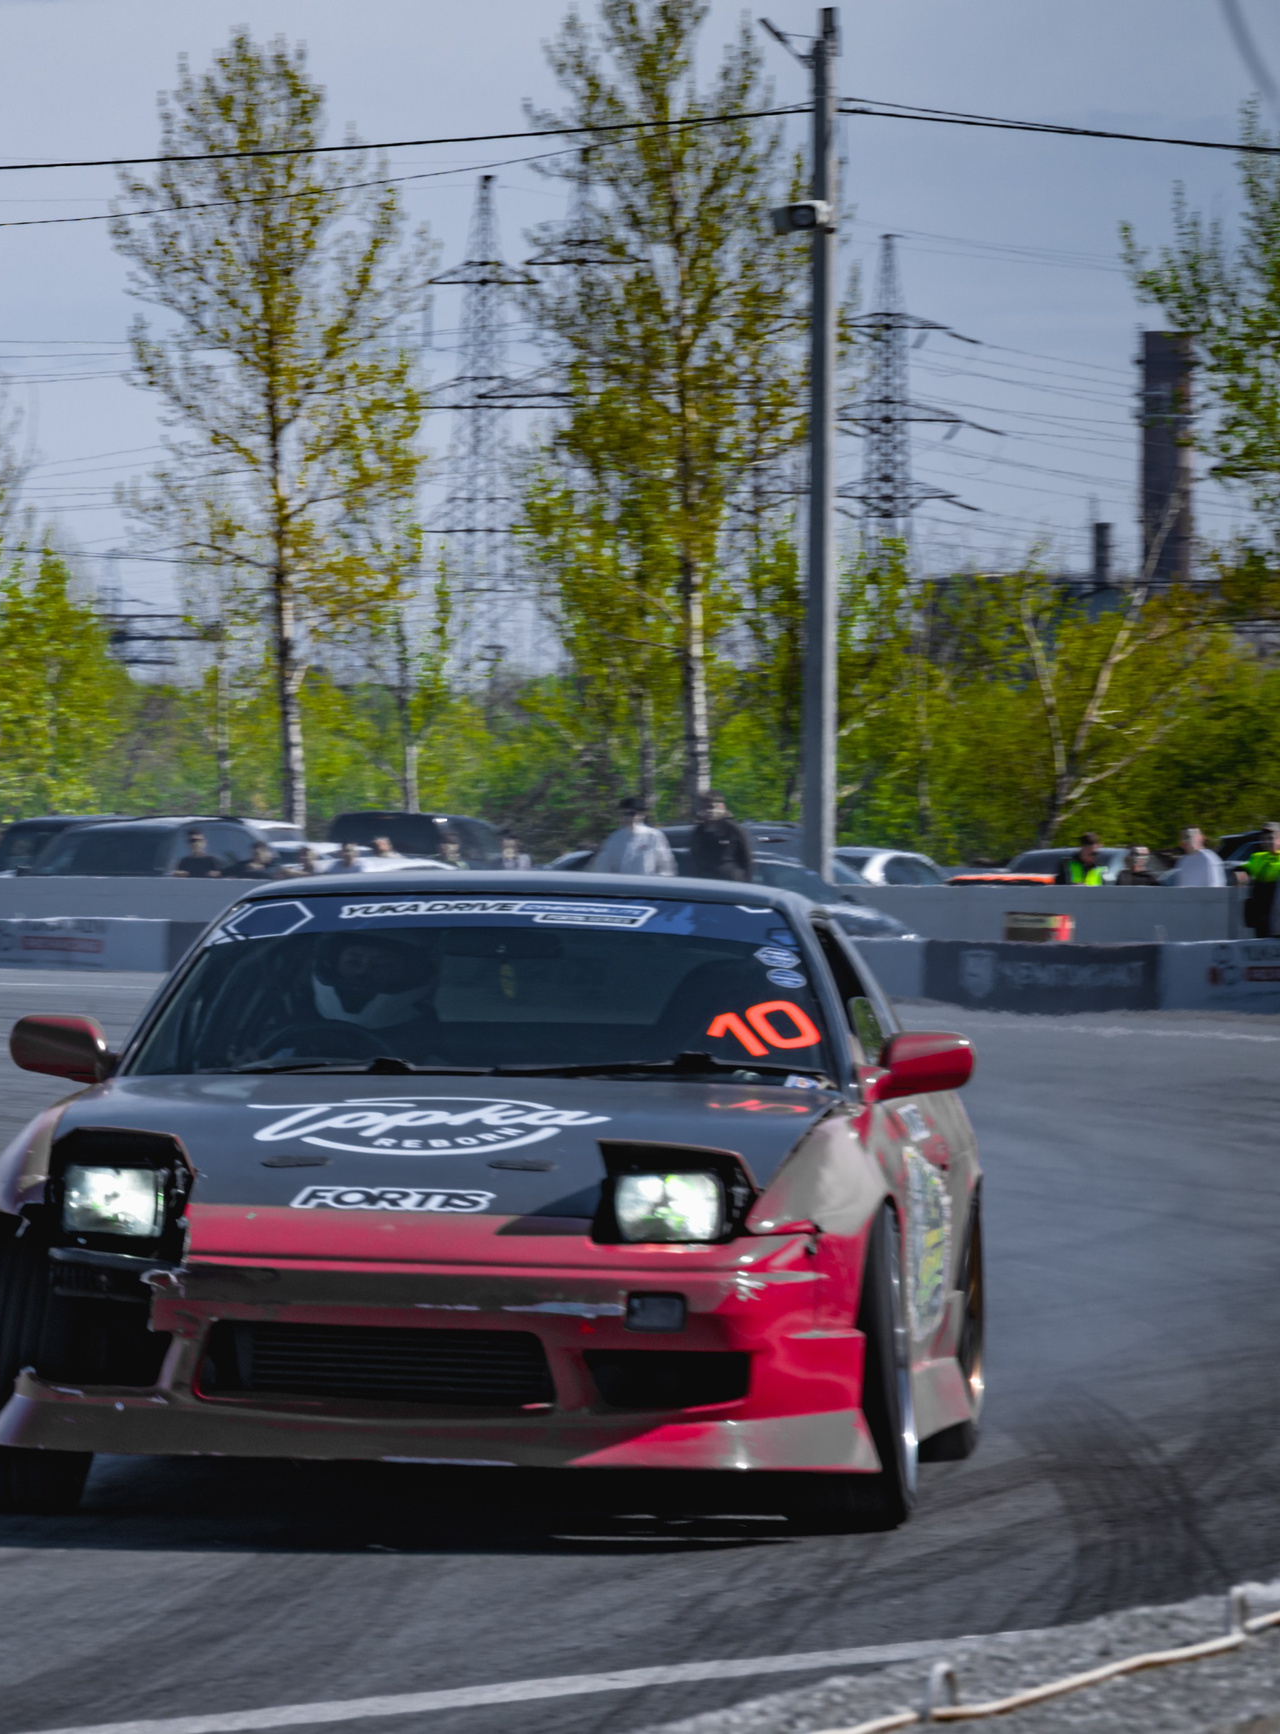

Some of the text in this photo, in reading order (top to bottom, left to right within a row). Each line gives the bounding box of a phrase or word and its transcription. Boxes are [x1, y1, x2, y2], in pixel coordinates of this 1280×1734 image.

[345, 902, 422, 917] YUKA
[423, 901, 518, 915] DRIVE
[706, 1000, 821, 1057] 10
[372, 1127, 526, 1148] REBORN
[296, 1188, 490, 1210] FORTIS
